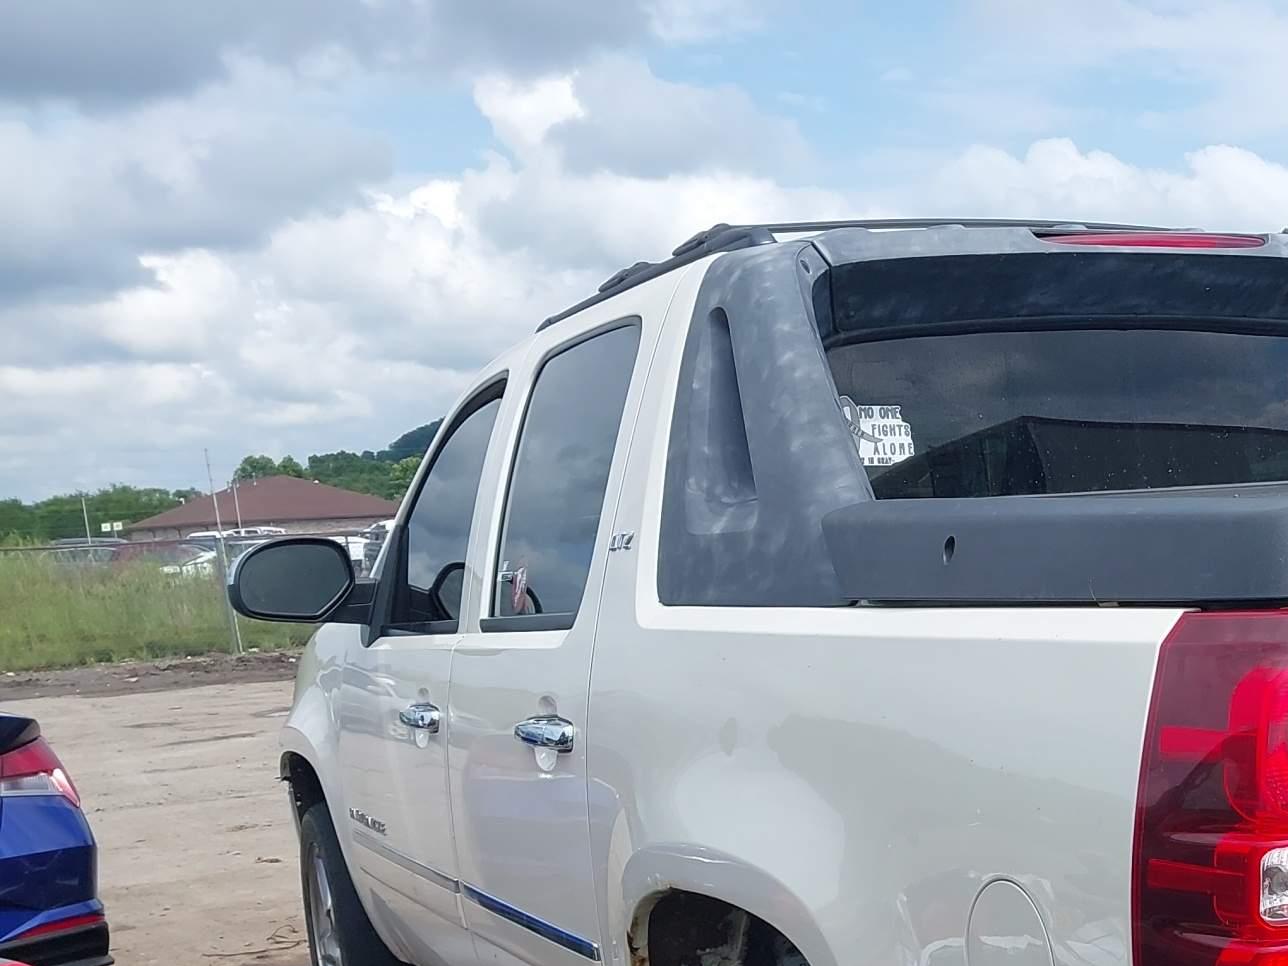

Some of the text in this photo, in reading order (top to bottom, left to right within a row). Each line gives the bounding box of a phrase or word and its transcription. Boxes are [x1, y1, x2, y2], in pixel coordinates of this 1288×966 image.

[859, 407, 900, 419] NO ONE
[871, 424, 910, 437] FIGHTS
[873, 442, 913, 455] ALONE
[609, 531, 635, 551] LTZ
